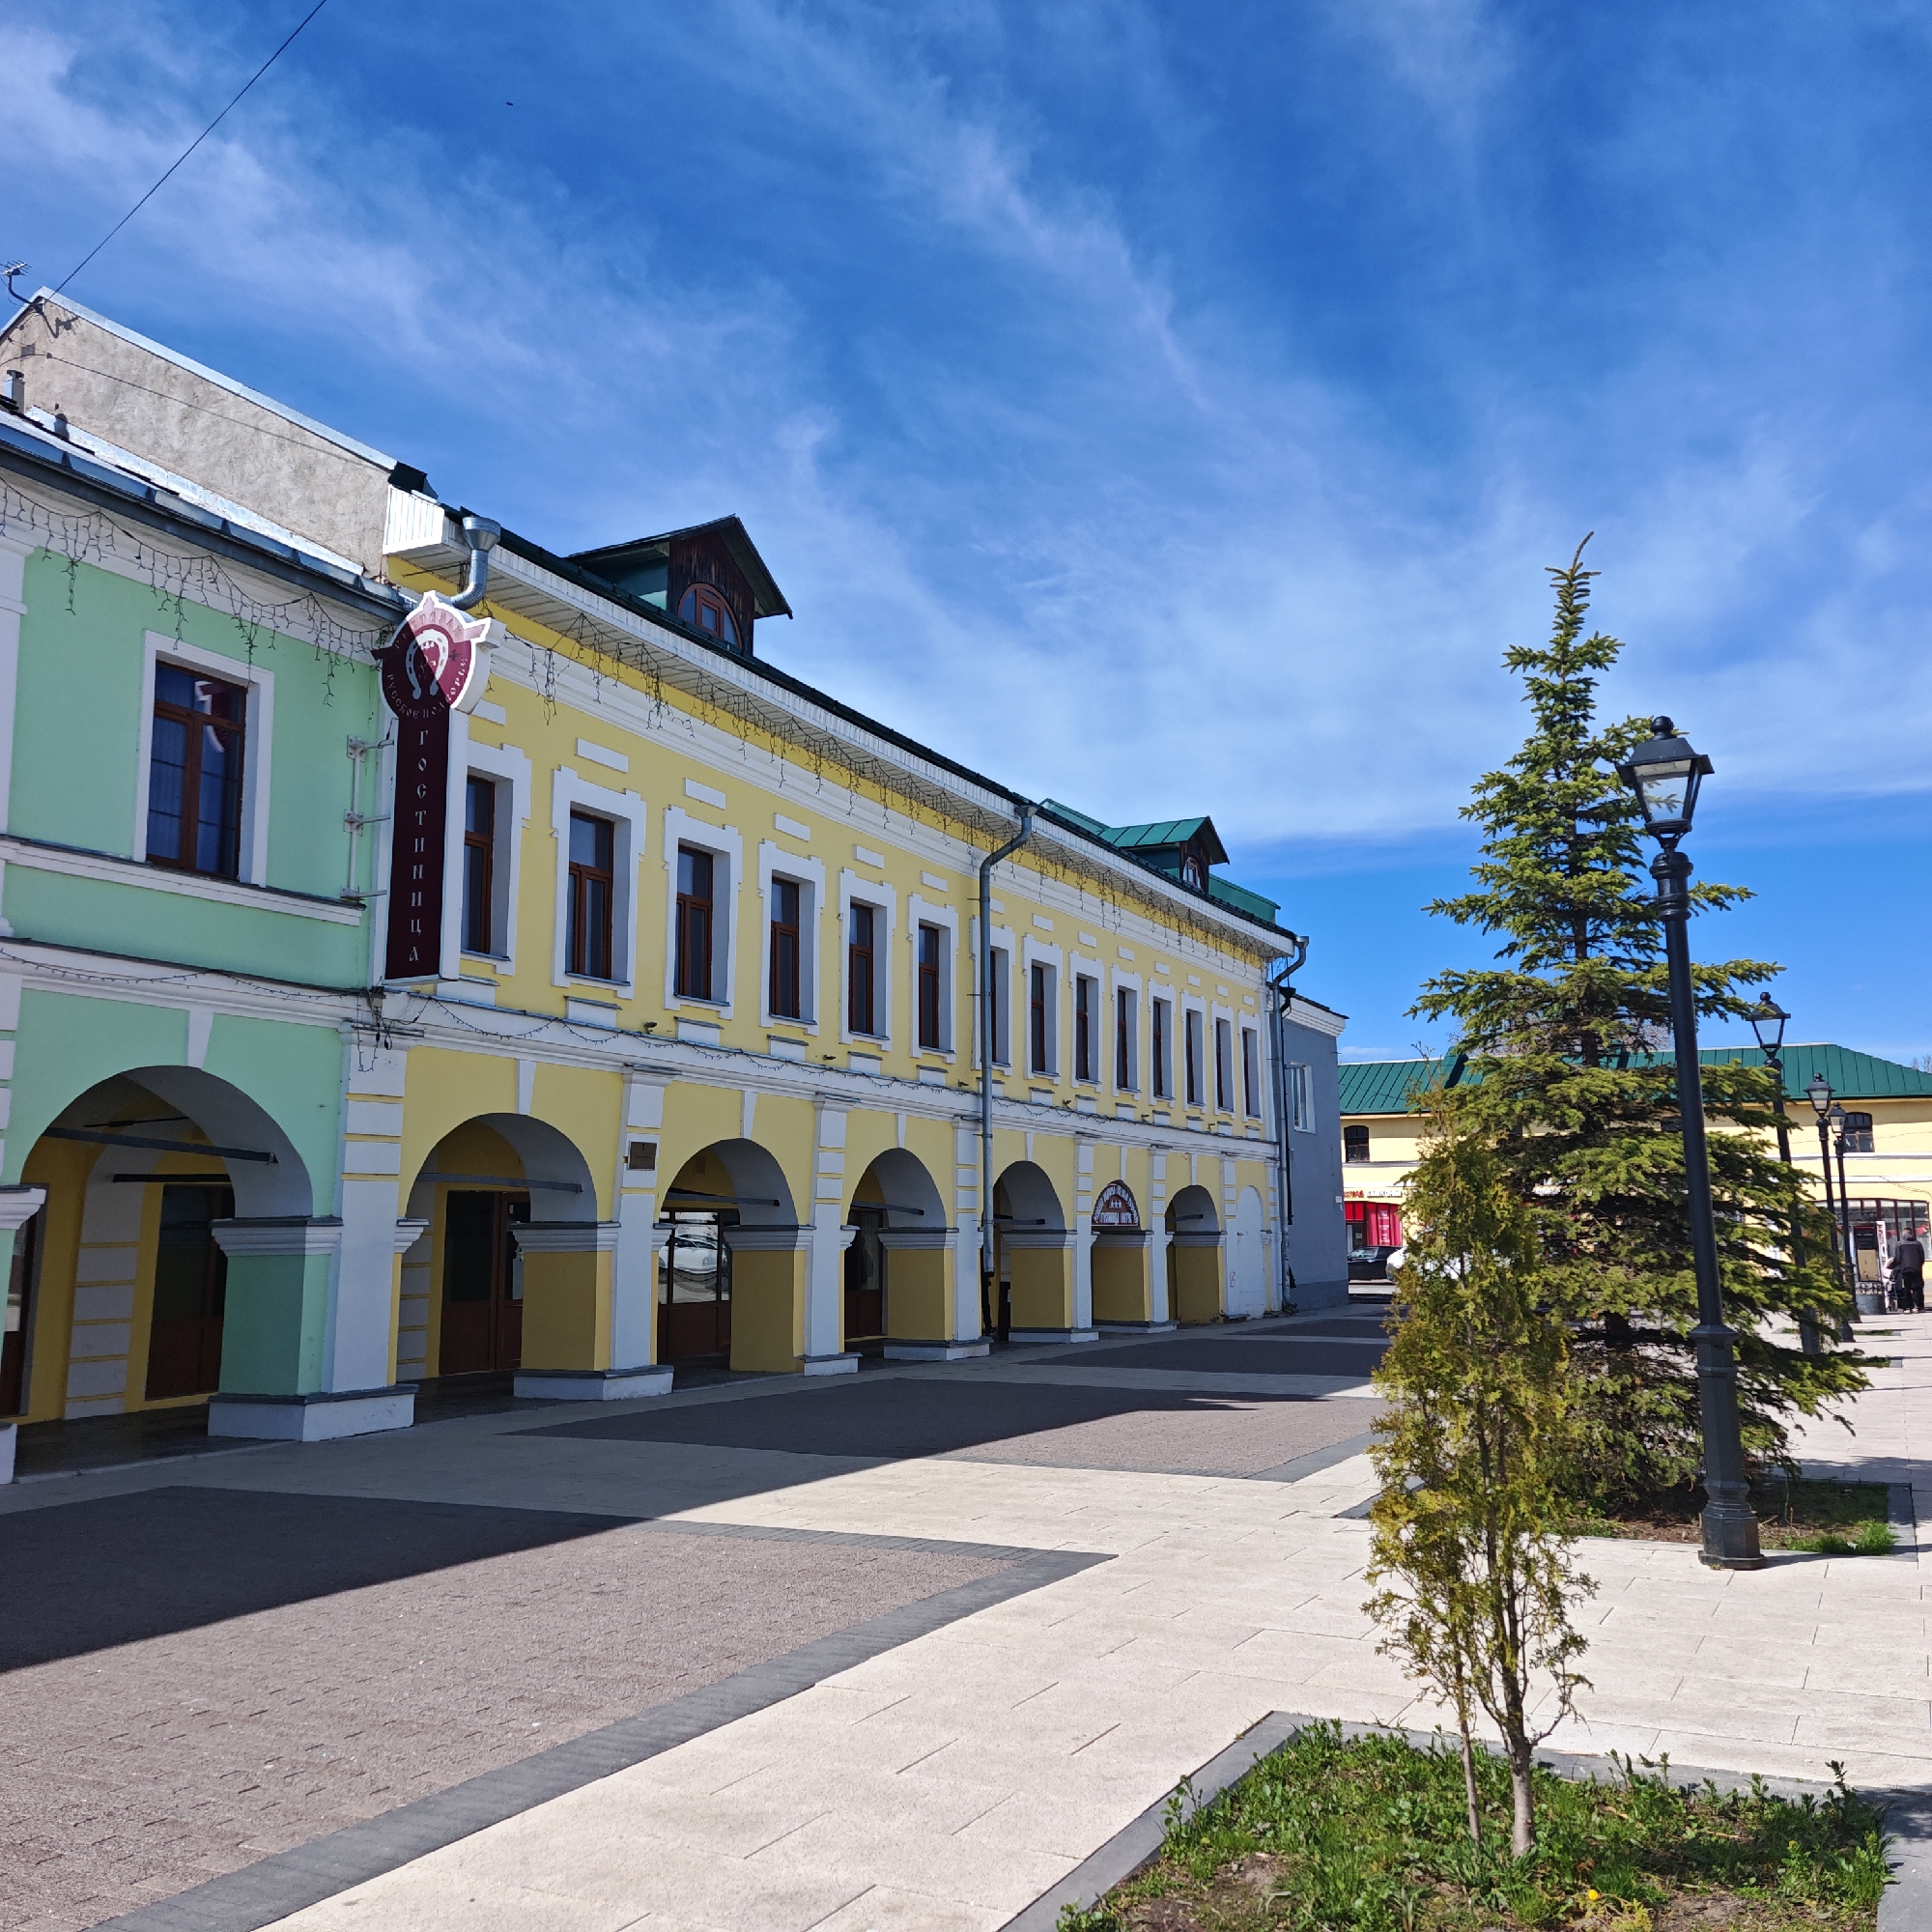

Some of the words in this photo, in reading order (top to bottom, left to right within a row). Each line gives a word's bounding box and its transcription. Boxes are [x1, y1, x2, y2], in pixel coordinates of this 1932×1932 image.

[387, 673, 420, 720] РУССКОЕ
[422, 657, 468, 720] ПОДВОРЬЕ
[409, 727, 429, 963] ГОСТИНИЦА
